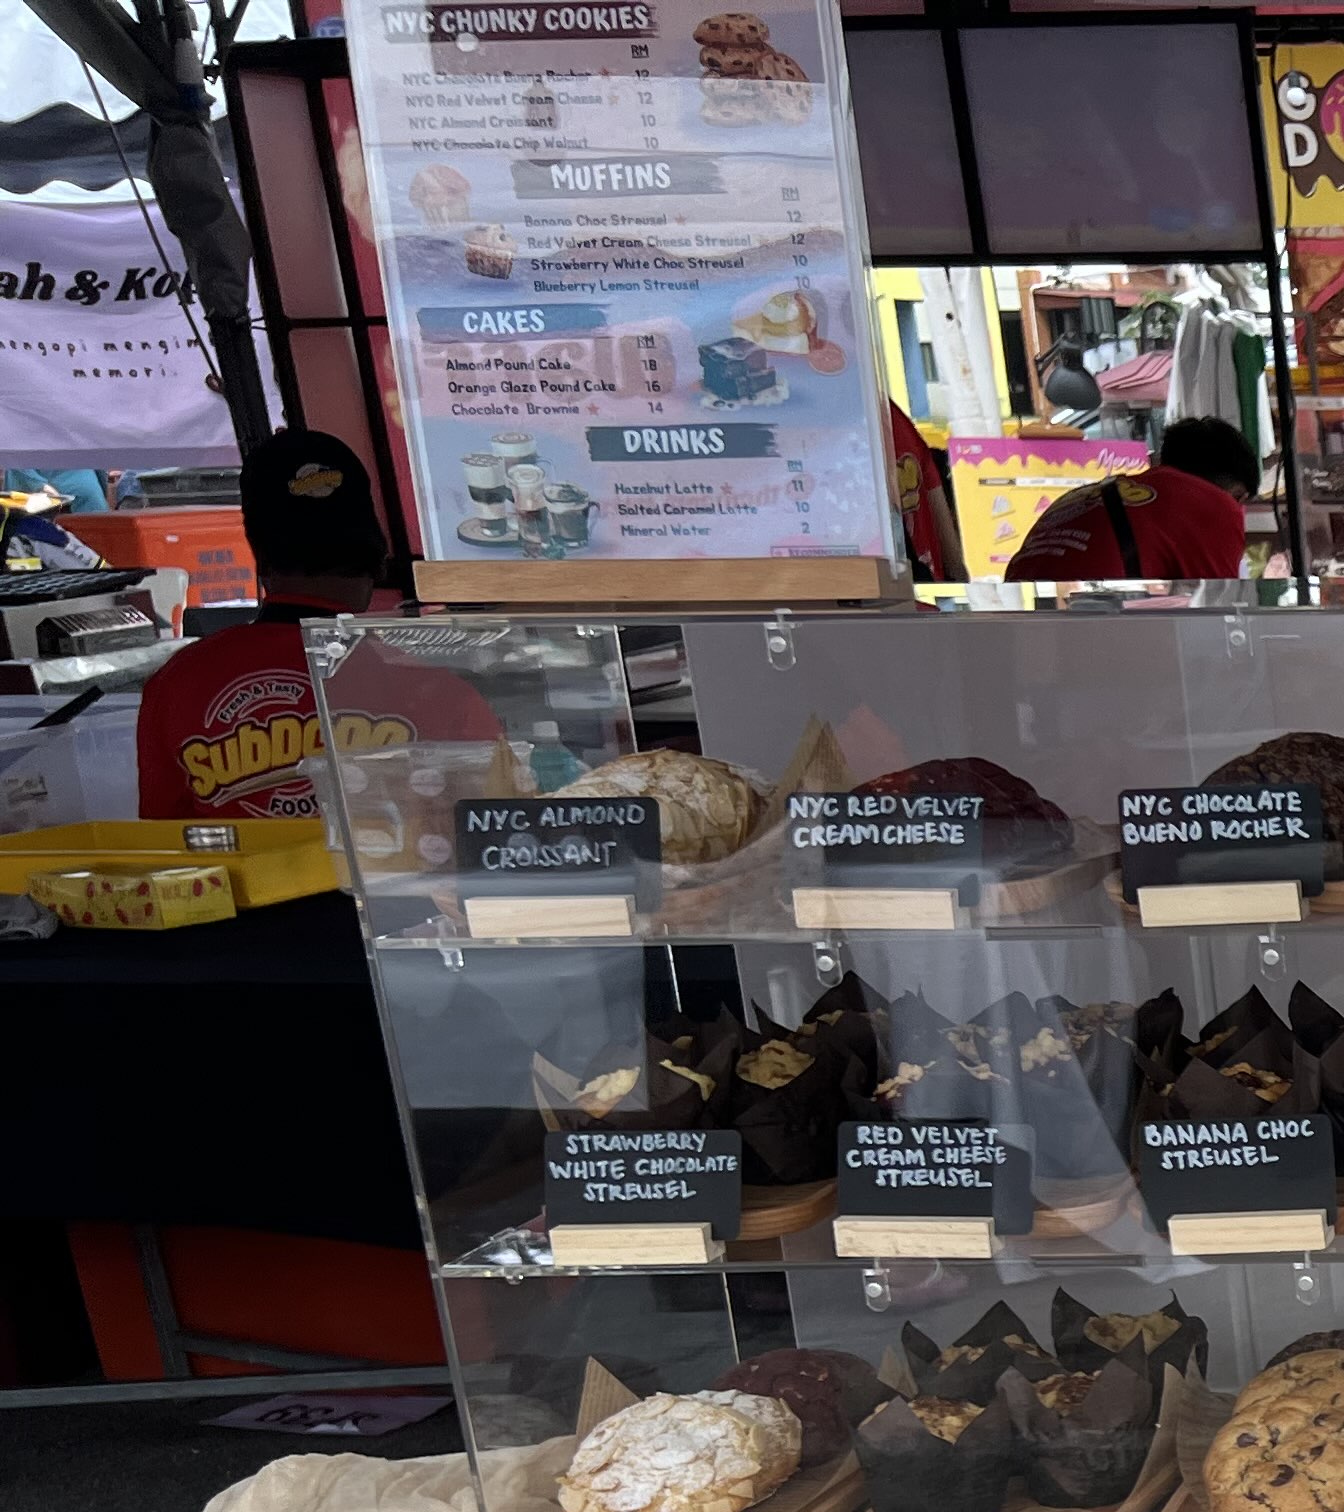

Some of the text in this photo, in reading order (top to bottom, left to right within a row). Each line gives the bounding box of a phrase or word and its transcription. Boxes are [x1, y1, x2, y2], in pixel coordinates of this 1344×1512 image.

[386, 5, 650, 35] NYC CHUNKY COOKIES
[631, 44, 649, 56] RM
[550, 162, 672, 191] MUFFINS
[530, 255, 808, 272] Strawberry White Choc Streusel 10
[65, 270, 110, 305] &
[533, 278, 700, 294] Blueberry Lemon Streusel
[463, 308, 546, 335] CAKES
[446, 358, 657, 371] Almond Pound Cake 18
[448, 379, 661, 396] Orange Glaze Pound Cake 16
[451, 402, 663, 416] Chocolate Brownie 14
[623, 427, 725, 455] DRINKS
[615, 483, 670, 495] Hazelnut
[675, 482, 713, 494] Latte
[219, 690, 250, 721] Fresh
[267, 681, 304, 698] Tasty
[790, 796, 985, 819] NYC RED VELVET
[1123, 790, 1303, 817] NYC CHOCOLATE
[467, 804, 646, 832] NYC ALMOND
[1123, 816, 1310, 845] BUENO ROCHER
[793, 822, 965, 848] CREAM CHEESE
[482, 841, 616, 870] CROISSANT
[565, 1133, 707, 1154] STRAWBERRY
[857, 1126, 1001, 1145] RED VELVET
[1144, 1119, 1315, 1146] BANANA CHOC
[549, 1154, 738, 1180] WHITE CHOCOLATE
[846, 1146, 1007, 1168] CREAM CHEESE
[1161, 1144, 1280, 1170] STREUSEL
[874, 1167, 994, 1188] STREUSEL
[583, 1180, 697, 1202] STREUSEL
